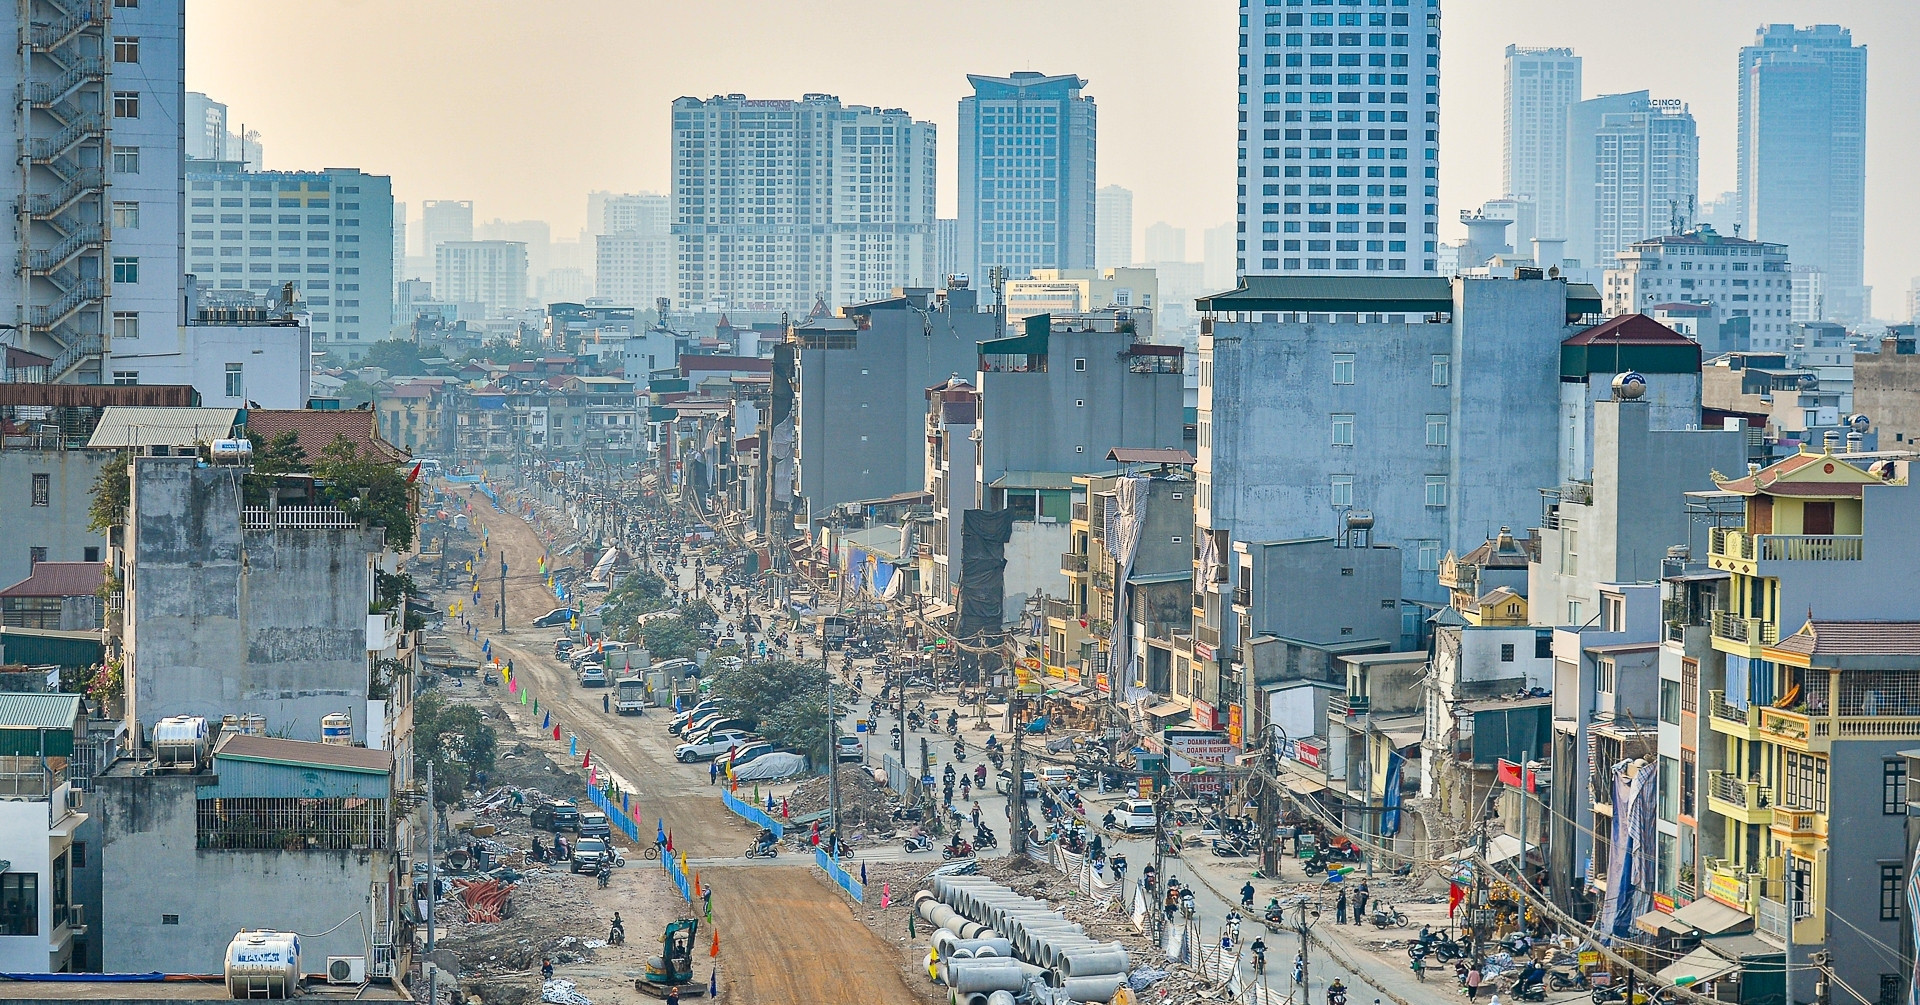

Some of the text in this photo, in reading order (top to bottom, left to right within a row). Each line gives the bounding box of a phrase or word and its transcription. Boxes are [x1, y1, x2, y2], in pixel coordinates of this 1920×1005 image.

[741, 100, 791, 108] HONG KONG
[1187, 738, 1207, 746] DOANH
[1186, 746, 1207, 754] DOANH
